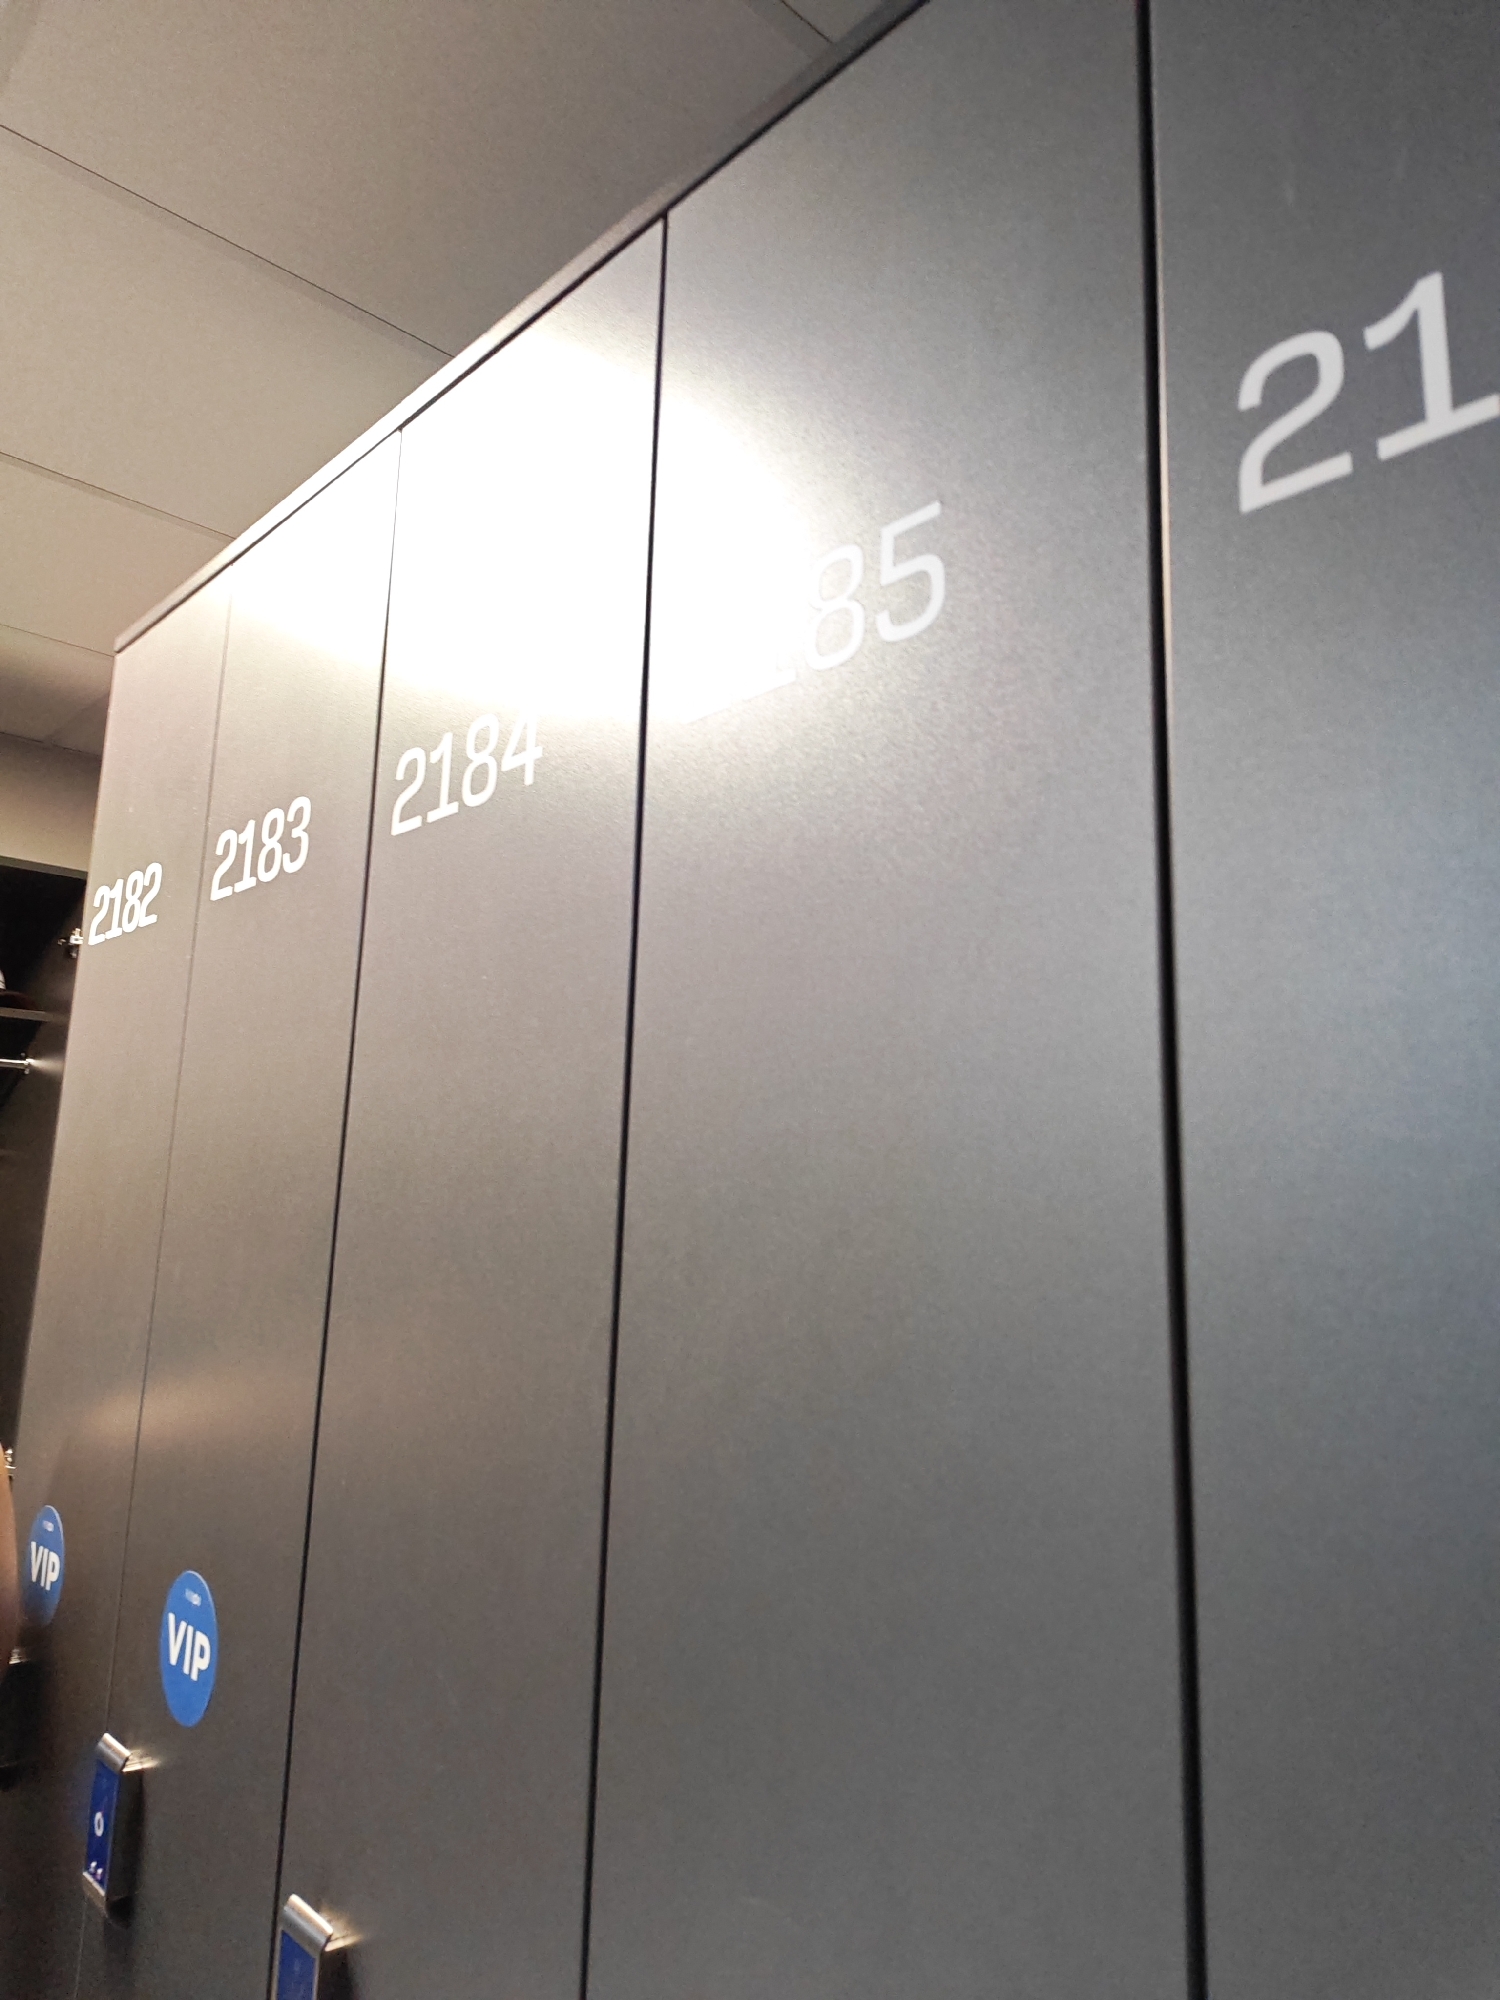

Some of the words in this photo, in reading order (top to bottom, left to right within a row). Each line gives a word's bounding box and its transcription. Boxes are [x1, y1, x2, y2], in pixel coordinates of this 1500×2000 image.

[391, 706, 543, 836] 2184
[210, 796, 311, 901] 2183
[88, 862, 162, 945] 2182
[30, 1541, 61, 1591] VIP
[167, 1612, 211, 1682] VIP
